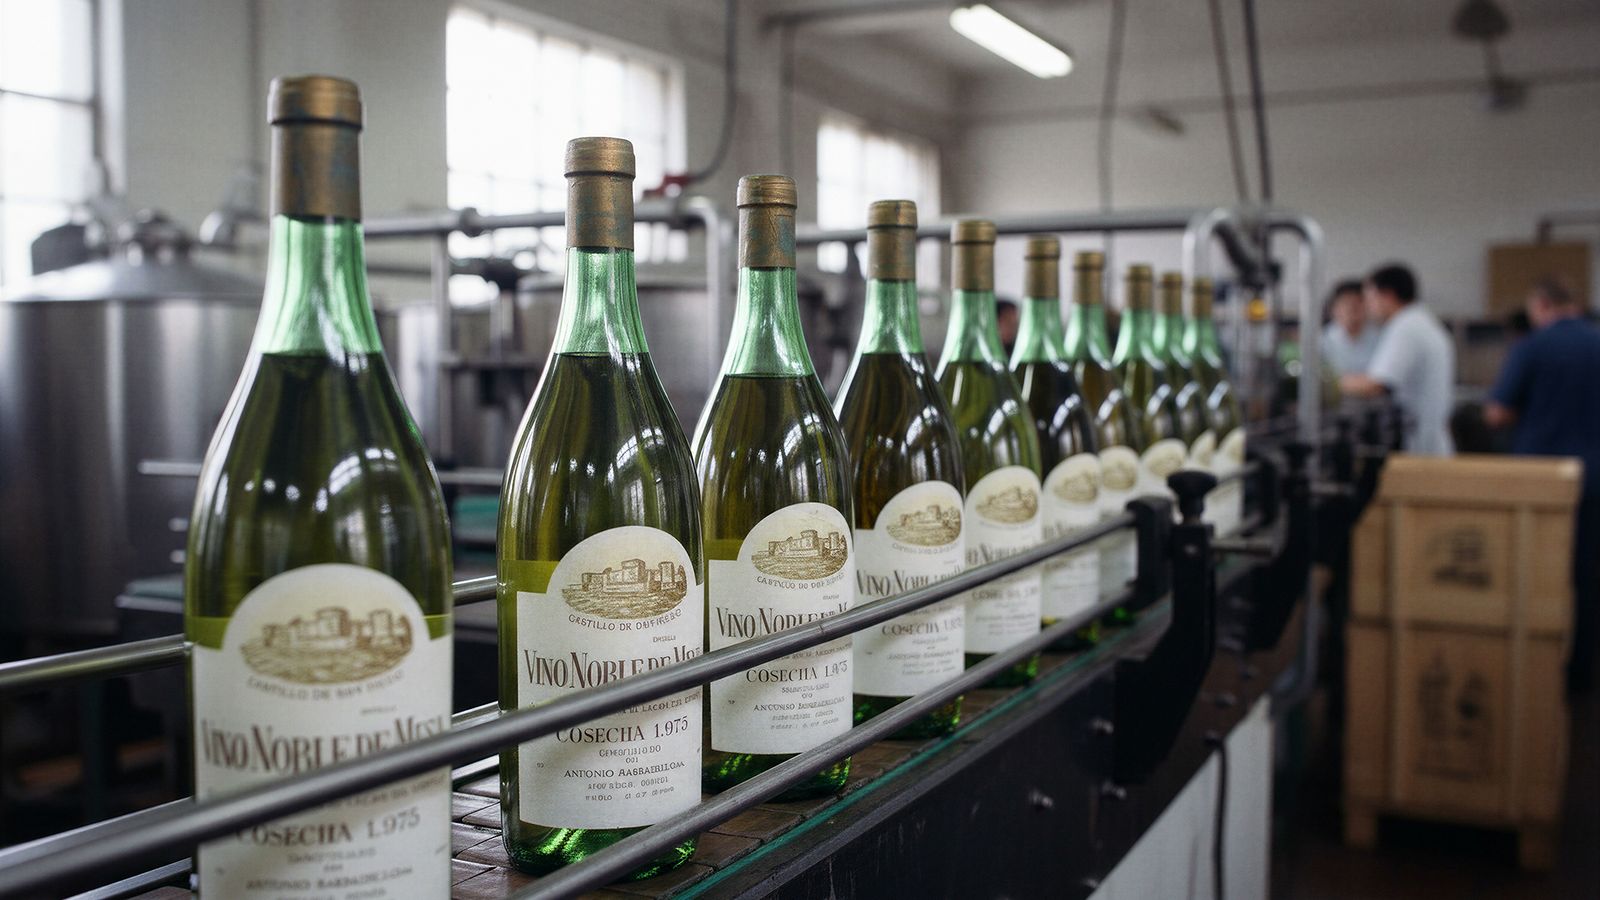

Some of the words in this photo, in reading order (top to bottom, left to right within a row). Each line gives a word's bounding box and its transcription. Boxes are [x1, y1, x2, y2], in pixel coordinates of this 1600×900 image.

[716, 606, 756, 639] VINO
[524, 649, 568, 688] VINO
[746, 667, 818, 683] COSECHA
[556, 725, 645, 744] COSECHA
[653, 715, 689, 739] 1.975
